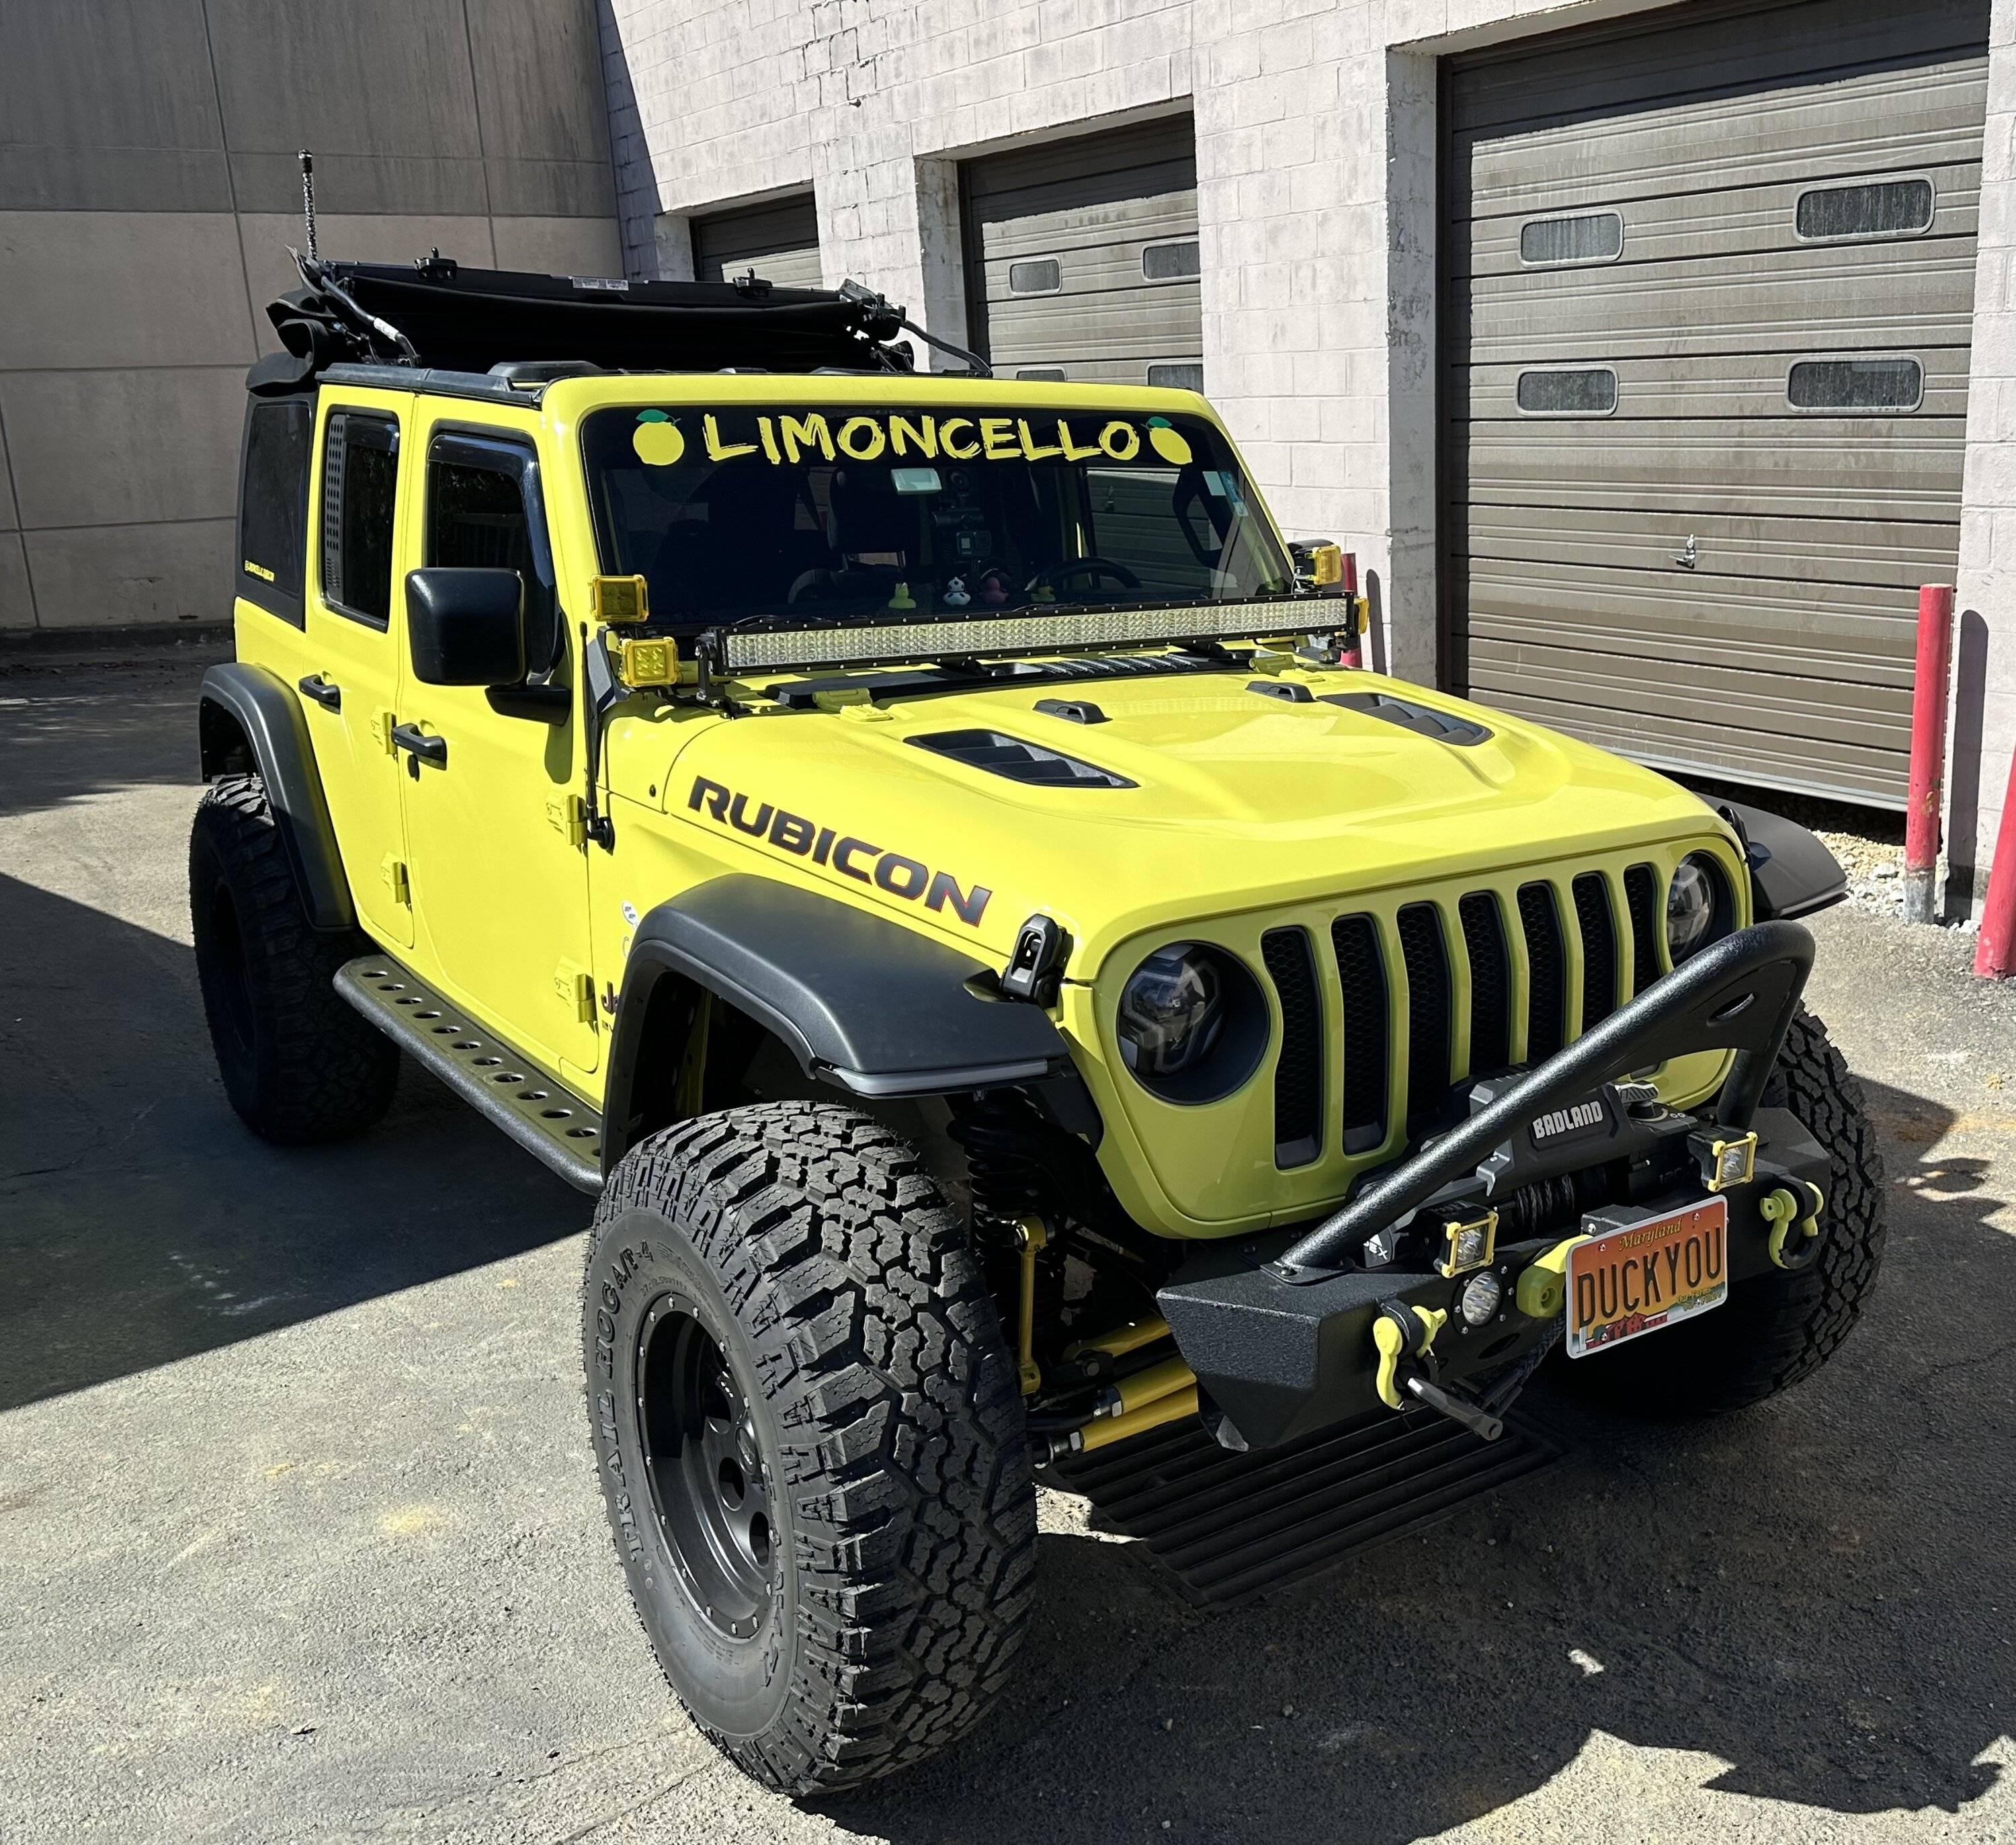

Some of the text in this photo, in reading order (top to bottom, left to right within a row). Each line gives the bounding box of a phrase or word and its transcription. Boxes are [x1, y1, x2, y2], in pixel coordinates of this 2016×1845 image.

[702, 413, 1140, 464] LIMONCELLO
[687, 775, 993, 928] RUBICON
[1533, 1100, 1603, 1140] BADLAND
[1618, 1214, 1683, 1252] Maryland
[1578, 1226, 1722, 1328] DUCKYOU
[595, 1280, 621, 1381] HOG
